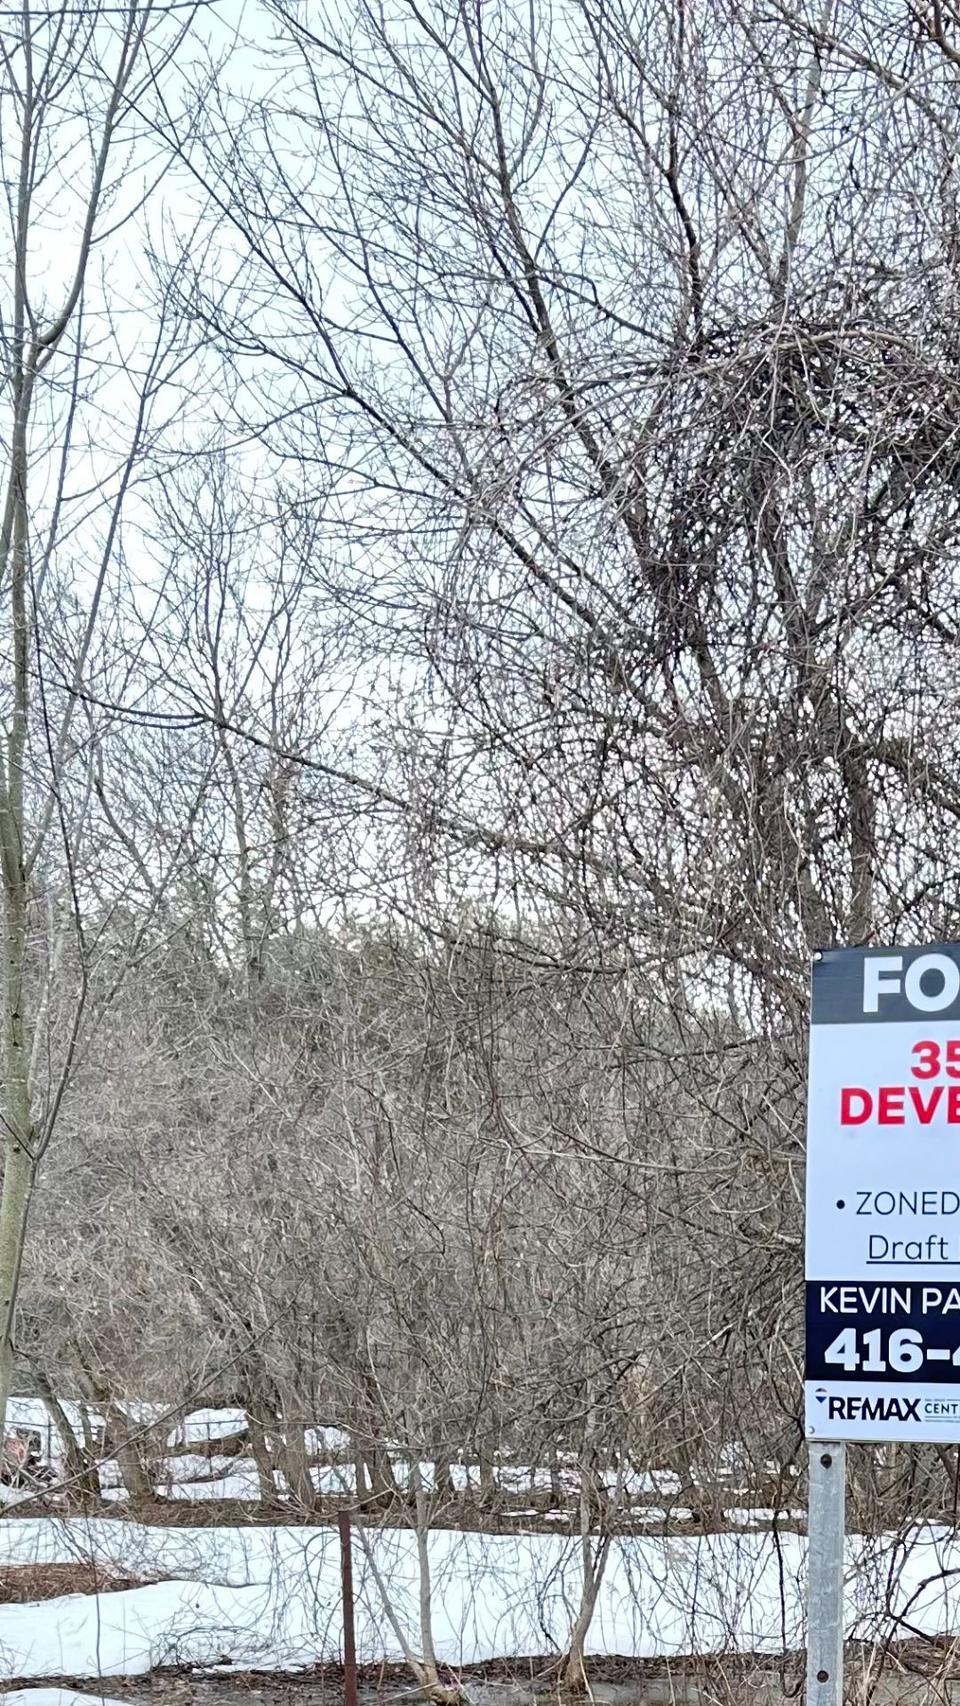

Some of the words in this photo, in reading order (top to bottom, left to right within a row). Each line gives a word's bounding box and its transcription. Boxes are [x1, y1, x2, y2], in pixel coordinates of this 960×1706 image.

[855, 1191, 960, 1216] ZONED
[868, 1235, 949, 1261] Draft
[820, 1286, 911, 1313] KEVIN
